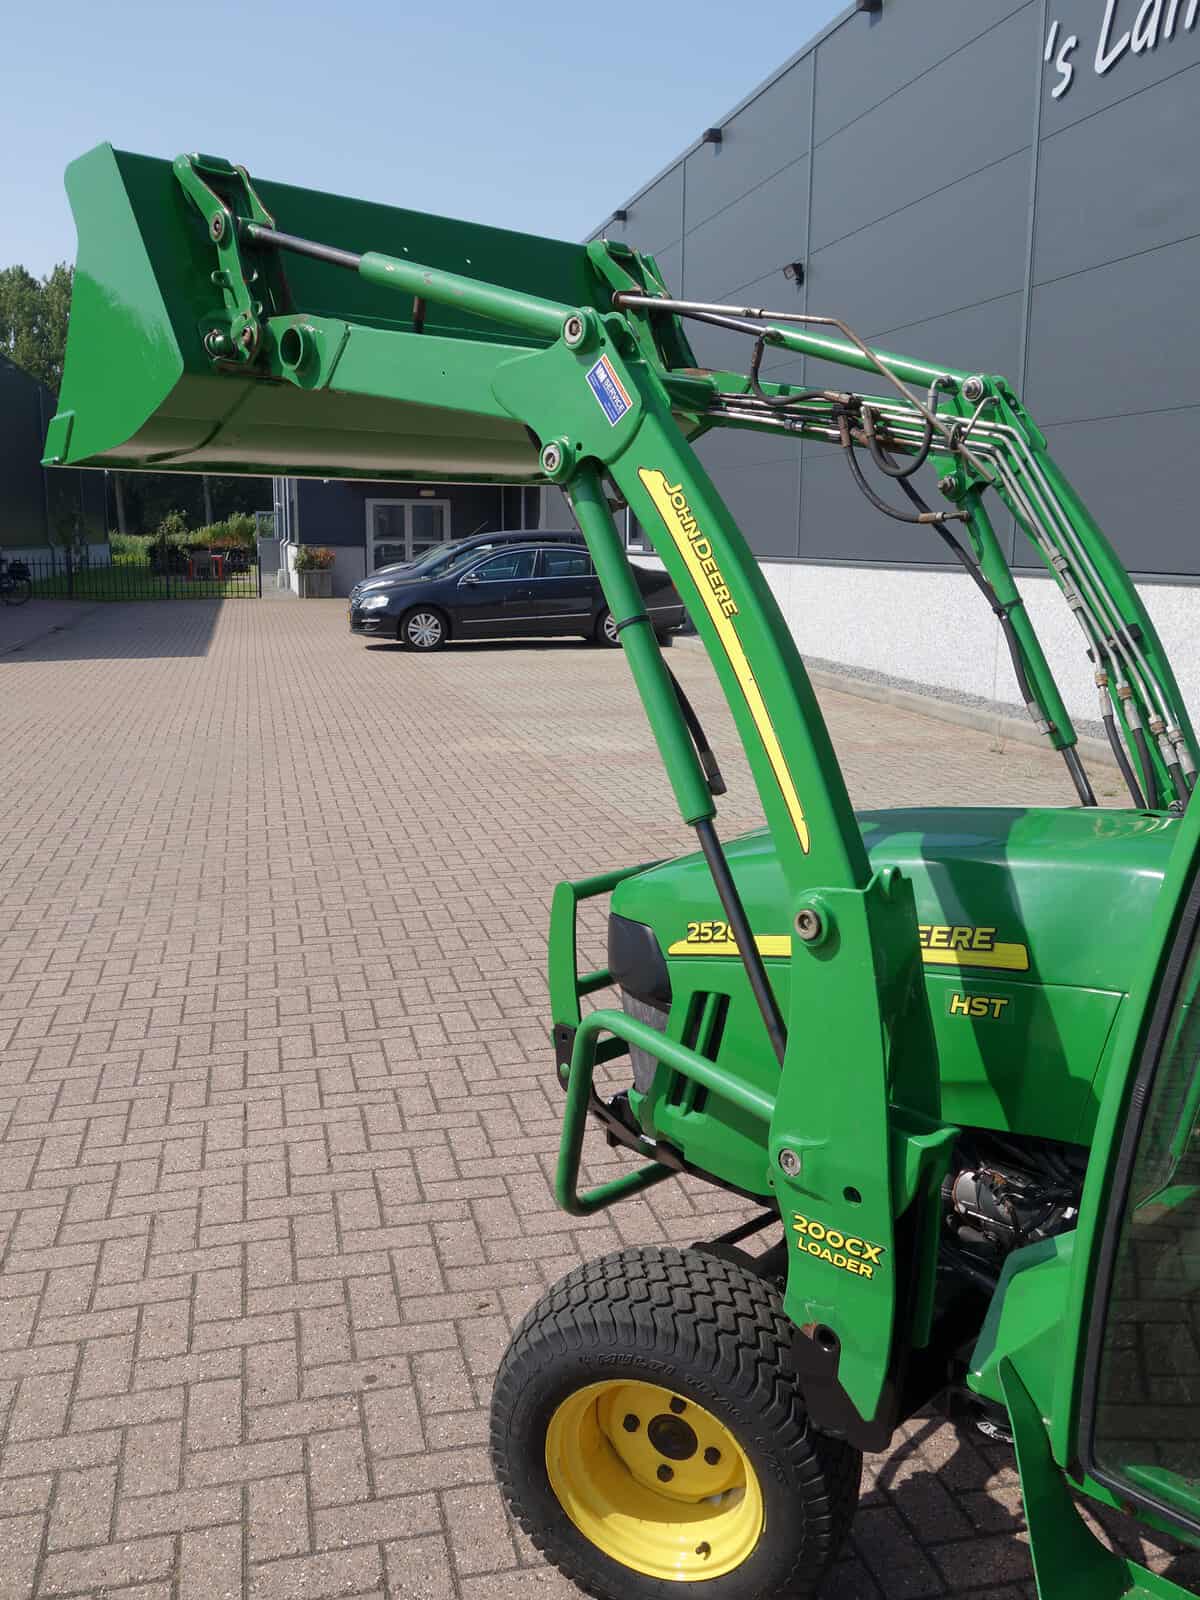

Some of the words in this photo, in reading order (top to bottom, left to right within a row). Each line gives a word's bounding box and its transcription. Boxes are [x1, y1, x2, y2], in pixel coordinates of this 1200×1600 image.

[1045, 20, 1077, 98] 's
[603, 378, 625, 413] SERVICE
[663, 480, 701, 542] JOHN
[692, 537, 739, 618] DEERE
[949, 993, 1009, 1019] HST
[792, 1213, 885, 1266] 200CX
[797, 1236, 874, 1280] LOADER
